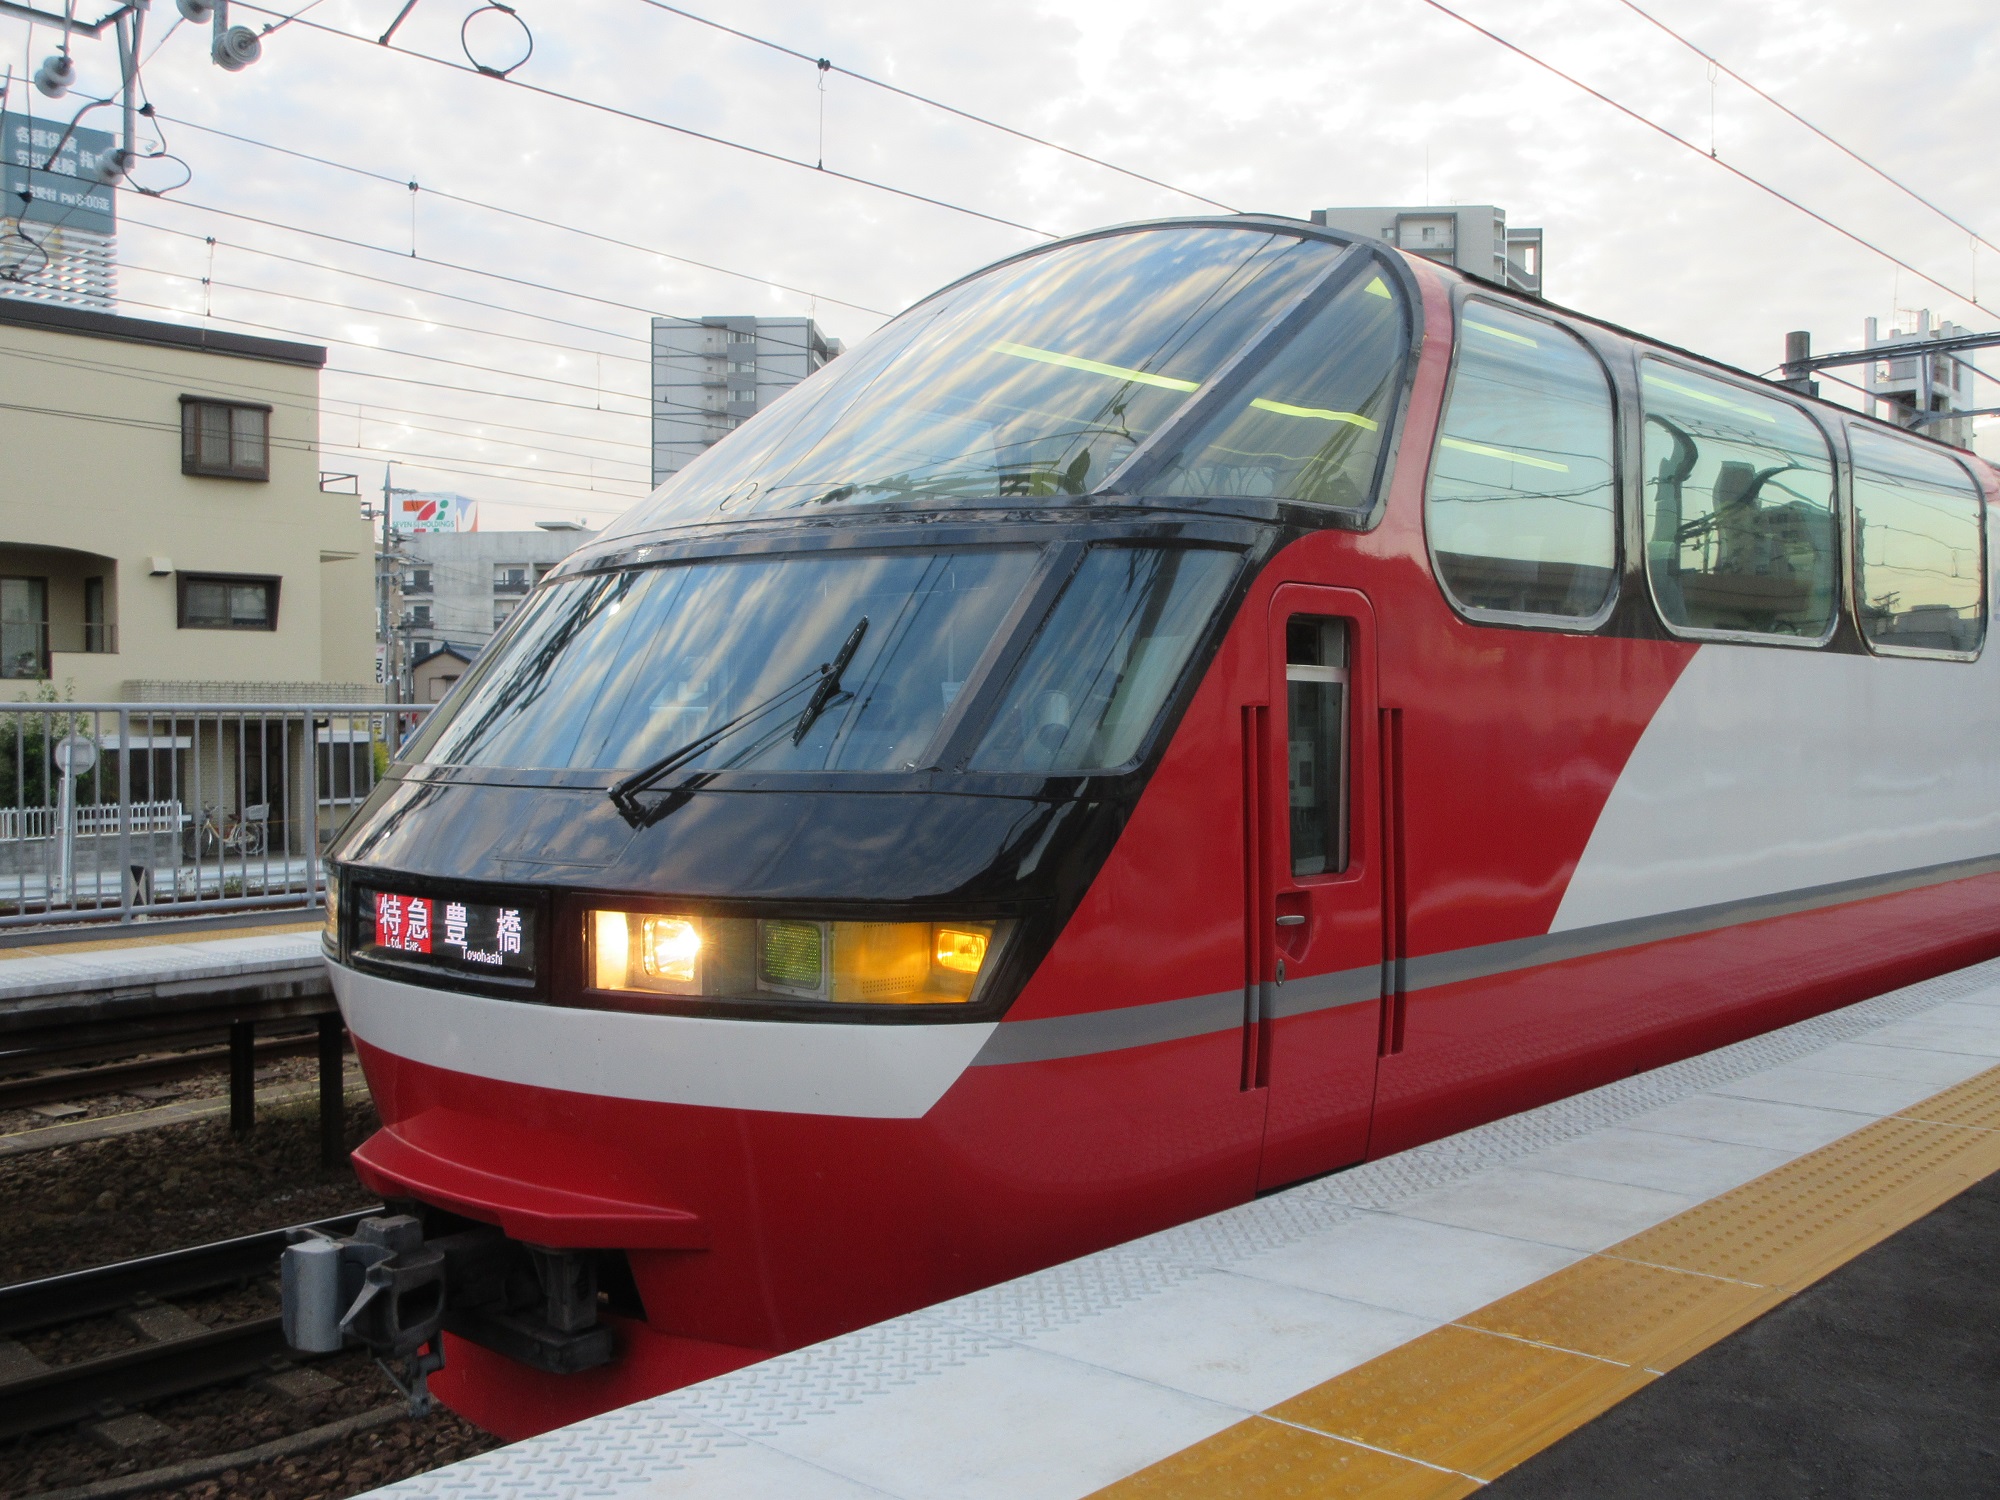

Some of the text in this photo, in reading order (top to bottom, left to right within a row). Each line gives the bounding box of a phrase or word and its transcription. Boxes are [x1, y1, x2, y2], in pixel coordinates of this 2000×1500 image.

[420, 520, 455, 528] HOLDINGS
[379, 893, 429, 940] 特急
[385, 934, 402, 949] Ltd.
[461, 945, 503, 966] Toyohashi
